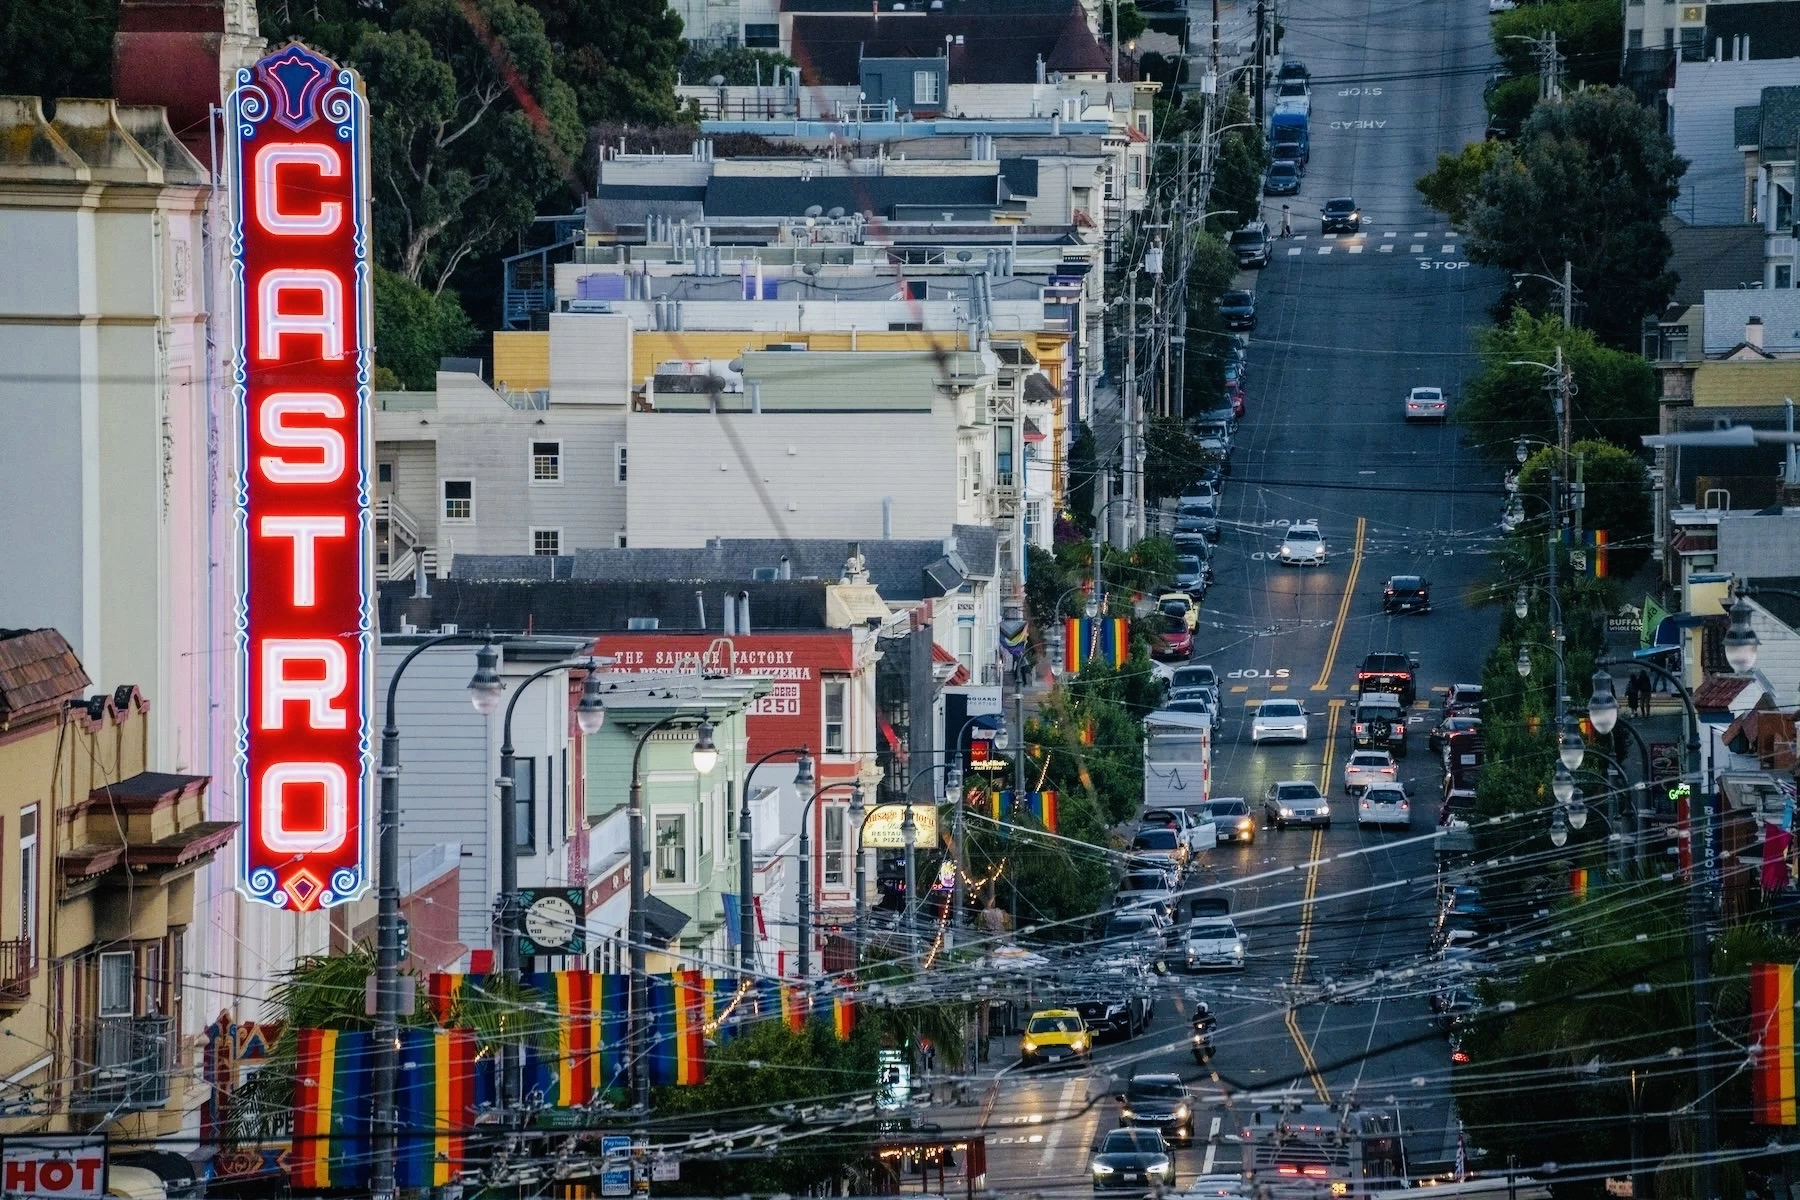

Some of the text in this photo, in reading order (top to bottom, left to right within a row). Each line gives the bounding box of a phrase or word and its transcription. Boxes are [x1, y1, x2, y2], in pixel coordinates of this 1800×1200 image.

[1338, 88, 1382, 96] STOP
[1330, 120, 1386, 129] AHEAD
[1420, 261, 1470, 270] STOP
[255, 143, 347, 854] CASTRO
[615, 651, 643, 664] THE
[733, 651, 794, 664] FACTORY
[1227, 669, 1290, 678] STOP
[1703, 806, 1715, 868] BISTRO
[6, 1158, 102, 1192] HOT
[1332, 1183, 1346, 1194] 35
